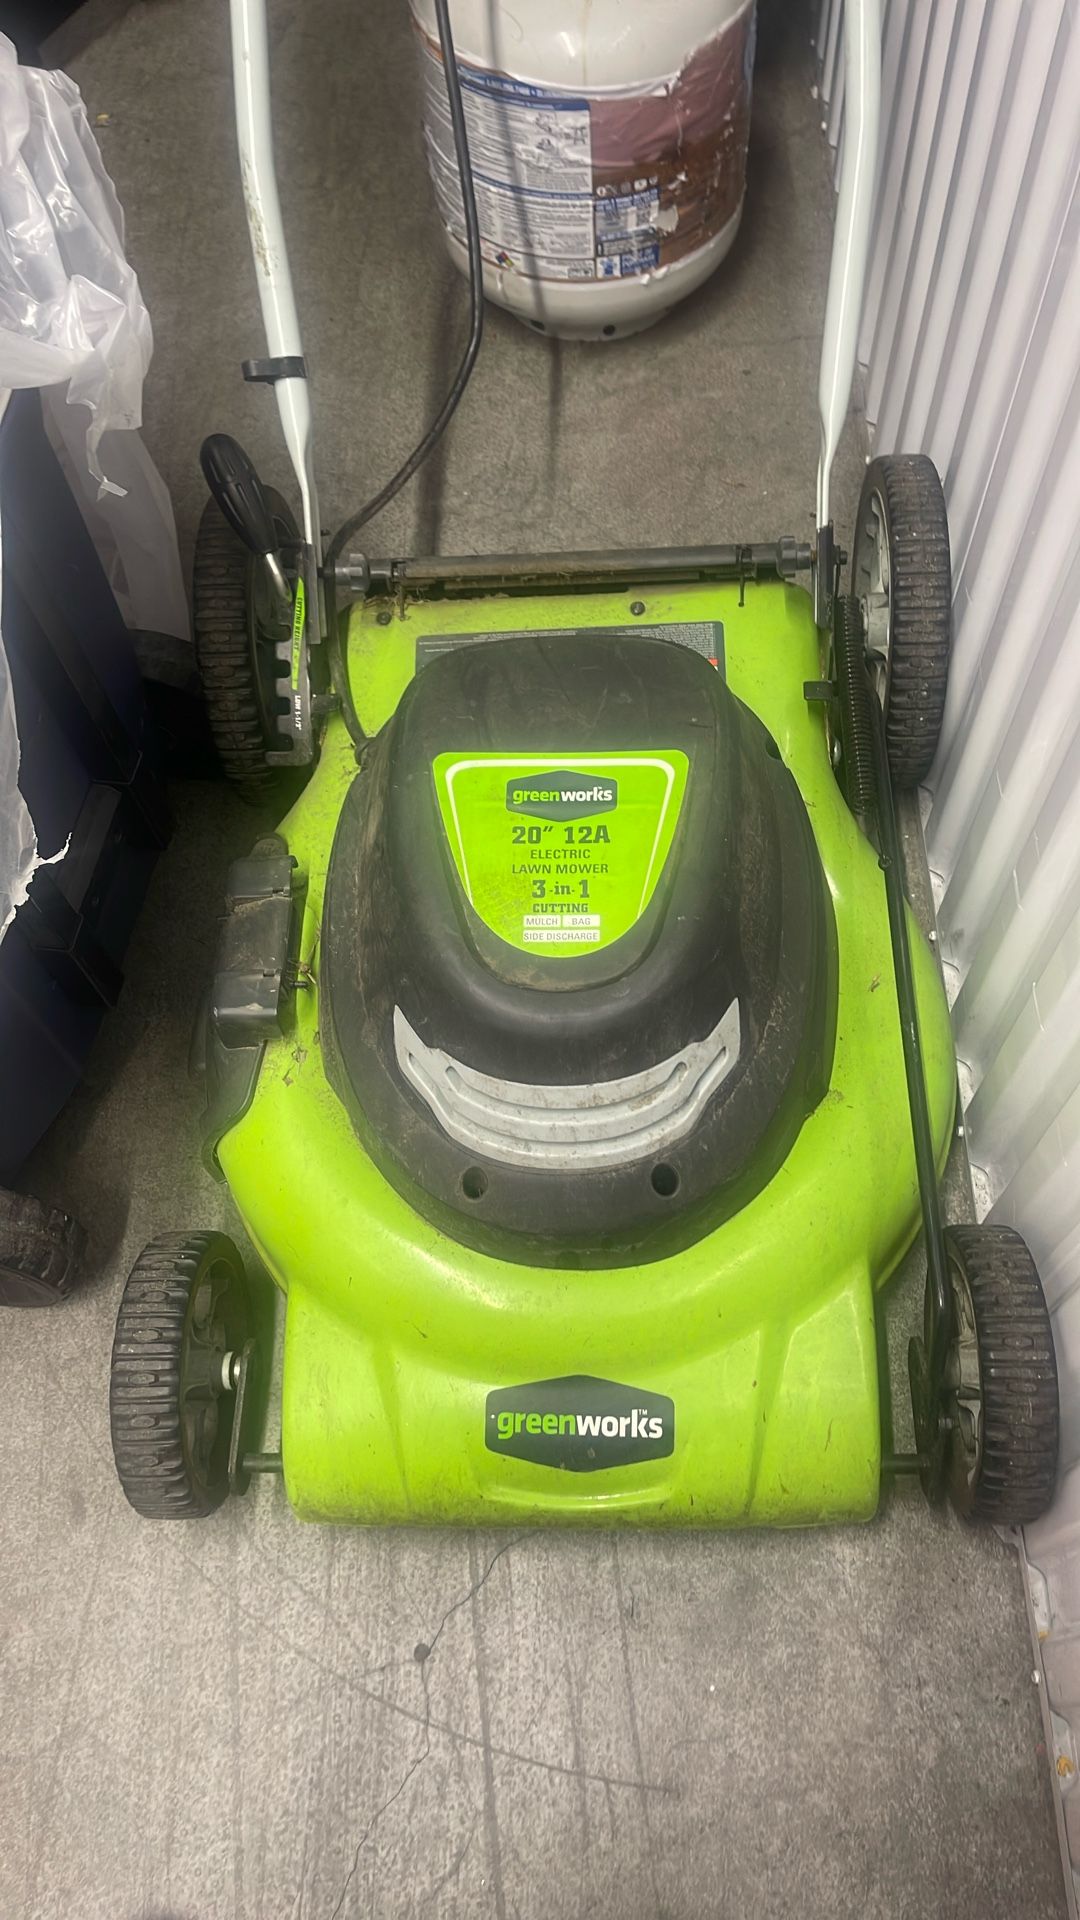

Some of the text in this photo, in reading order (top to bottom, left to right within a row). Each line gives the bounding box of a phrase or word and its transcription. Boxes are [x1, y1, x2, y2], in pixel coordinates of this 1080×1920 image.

[295, 597, 303, 624] CUTTING
[294, 695, 302, 710] LOW
[512, 786, 613, 804] greenworks
[512, 825, 611, 844] 20" 12A
[530, 848, 591, 860] ELECTRIC
[512, 863, 609, 874] LAWN MOWER
[532, 903, 589, 913] CUTTING
[526, 917, 591, 926] MULCH BAG
[523, 932, 598, 941] SIDE DISCHARGE
[497, 1408, 663, 1440] greenworks
